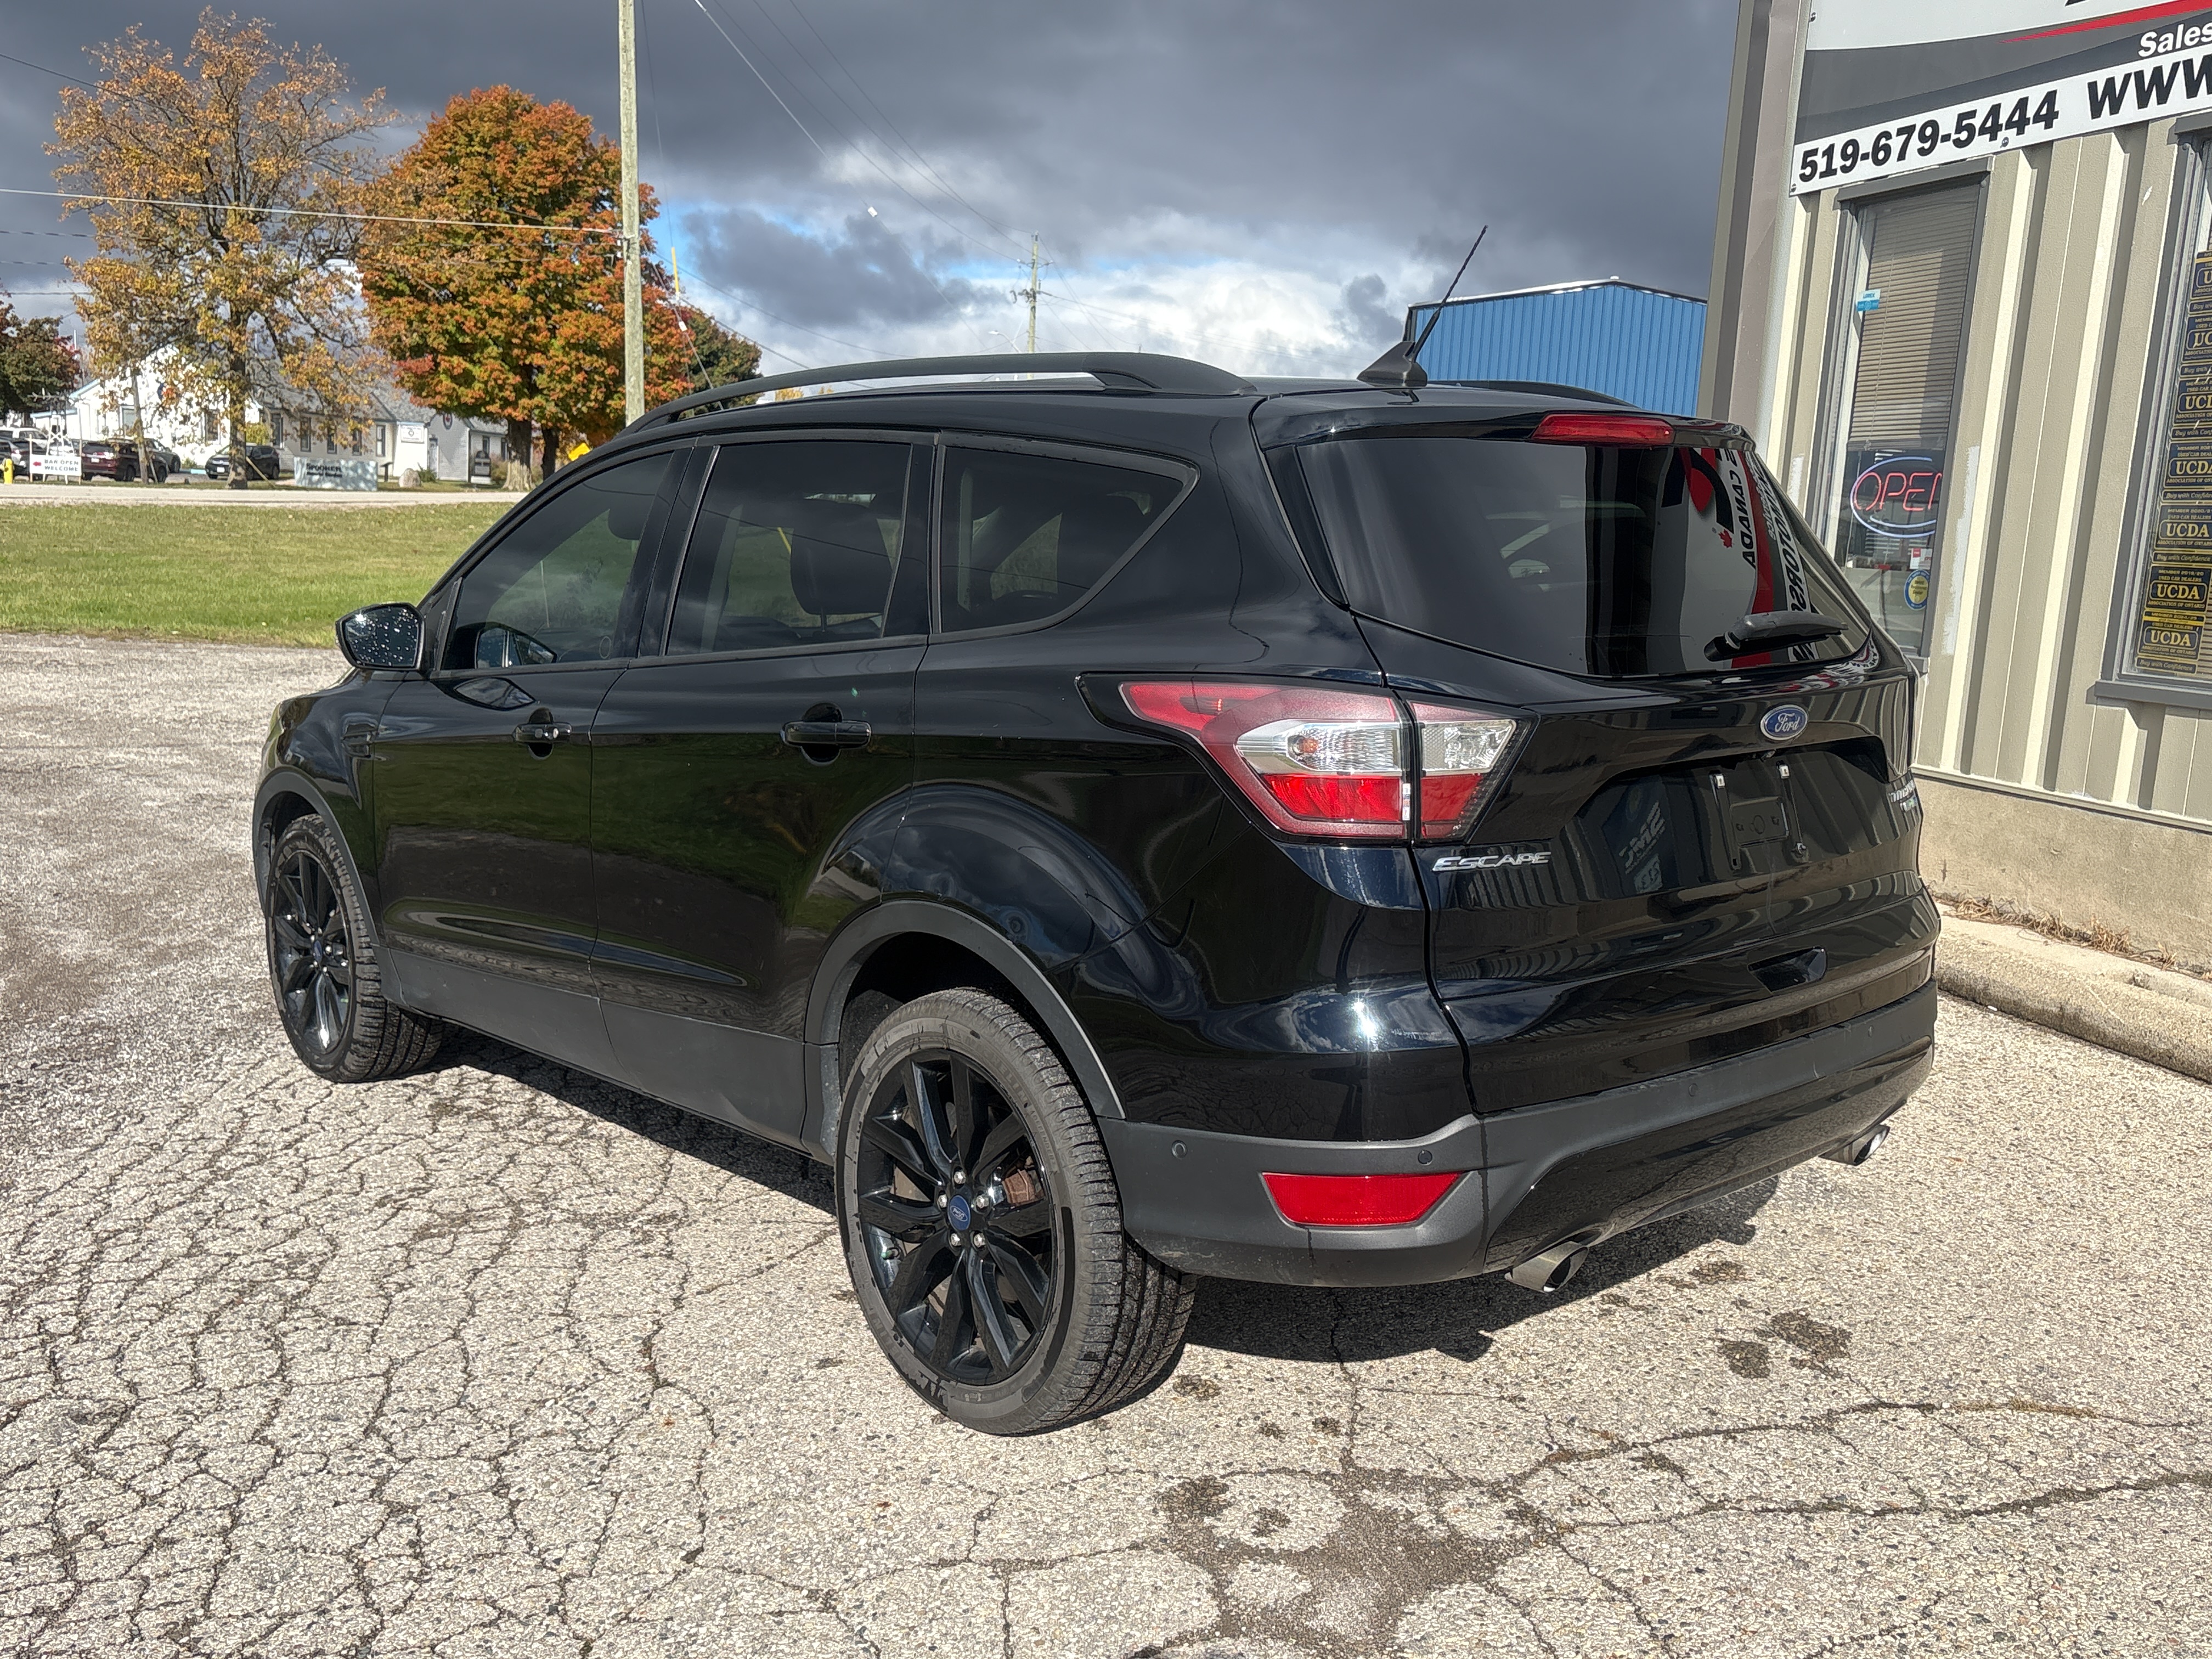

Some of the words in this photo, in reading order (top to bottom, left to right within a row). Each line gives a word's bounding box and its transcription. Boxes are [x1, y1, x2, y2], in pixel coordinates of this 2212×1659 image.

[2138, 22, 2212, 57] Sales
[1799, 89, 2059, 183] 519-679-5444
[2166, 523, 2210, 537] UCDA
[2157, 584, 2200, 600] UCDA
[2151, 630, 2191, 646] UCDA
[1774, 713, 1801, 733] Ford
[1432, 851, 1552, 872] ESCAPE
